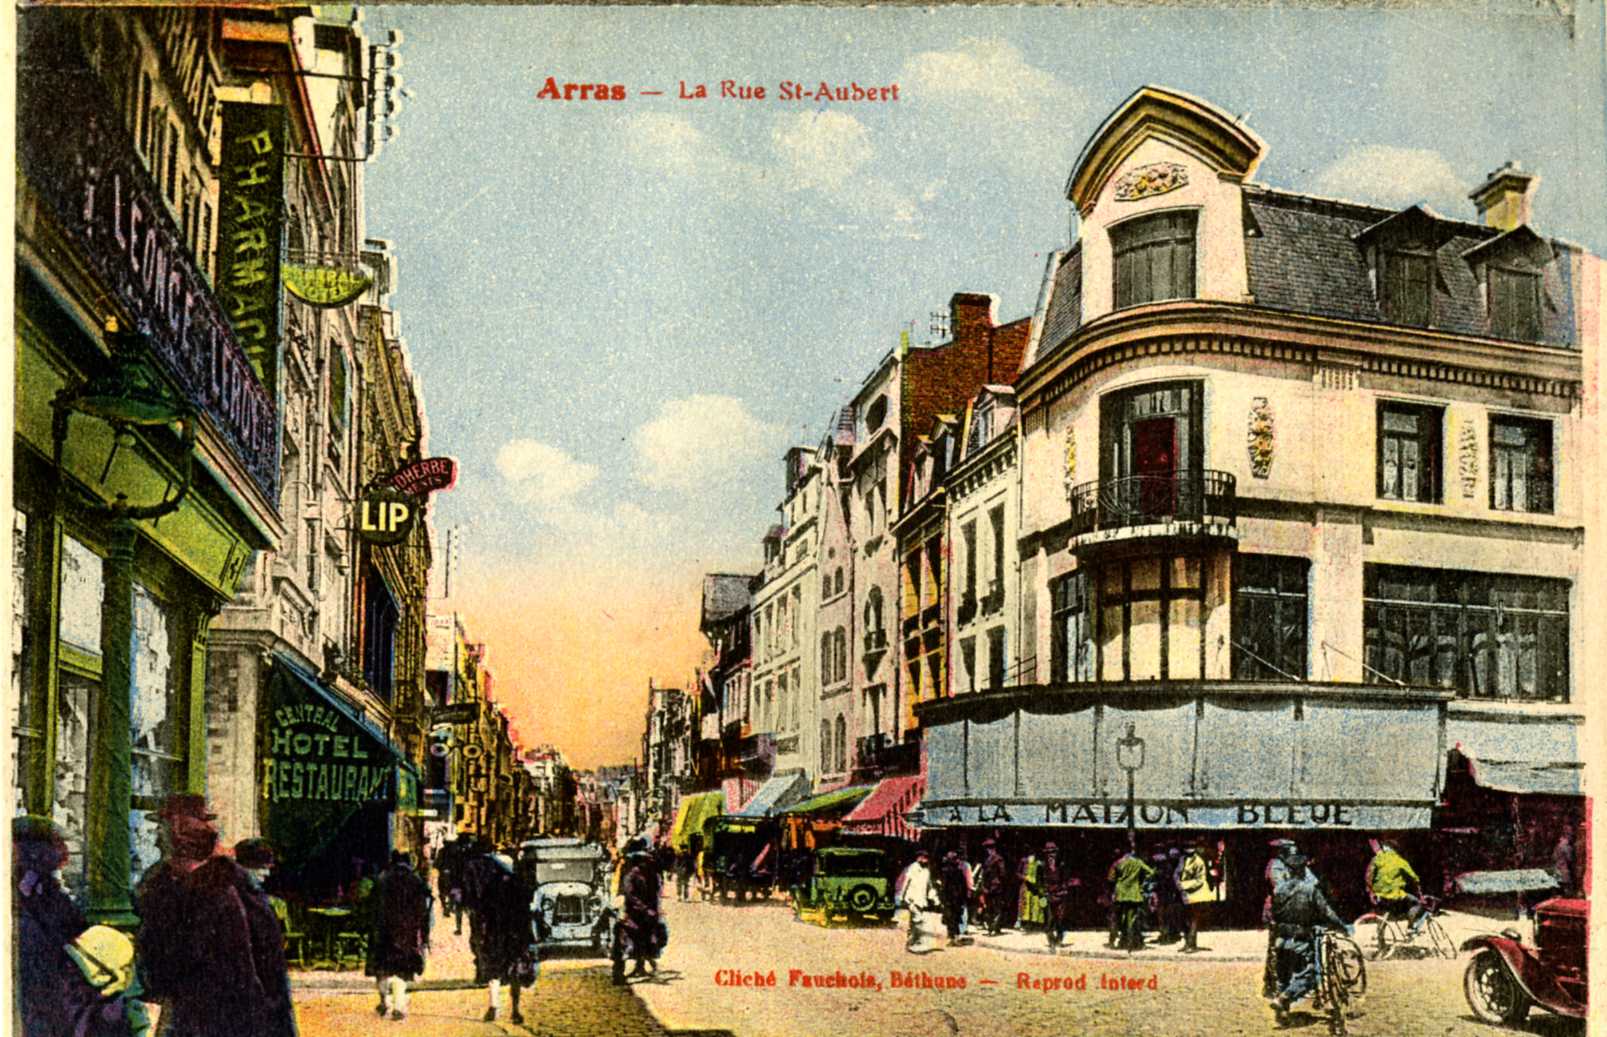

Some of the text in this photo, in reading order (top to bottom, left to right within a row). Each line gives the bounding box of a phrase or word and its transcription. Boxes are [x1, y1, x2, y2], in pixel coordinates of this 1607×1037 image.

[361, 500, 409, 532] LIP
[275, 703, 341, 733] CENTRAL
[271, 727, 368, 759] HOTEL
[979, 804, 1011, 822] LA
[1237, 803, 1351, 826] BLEUE
